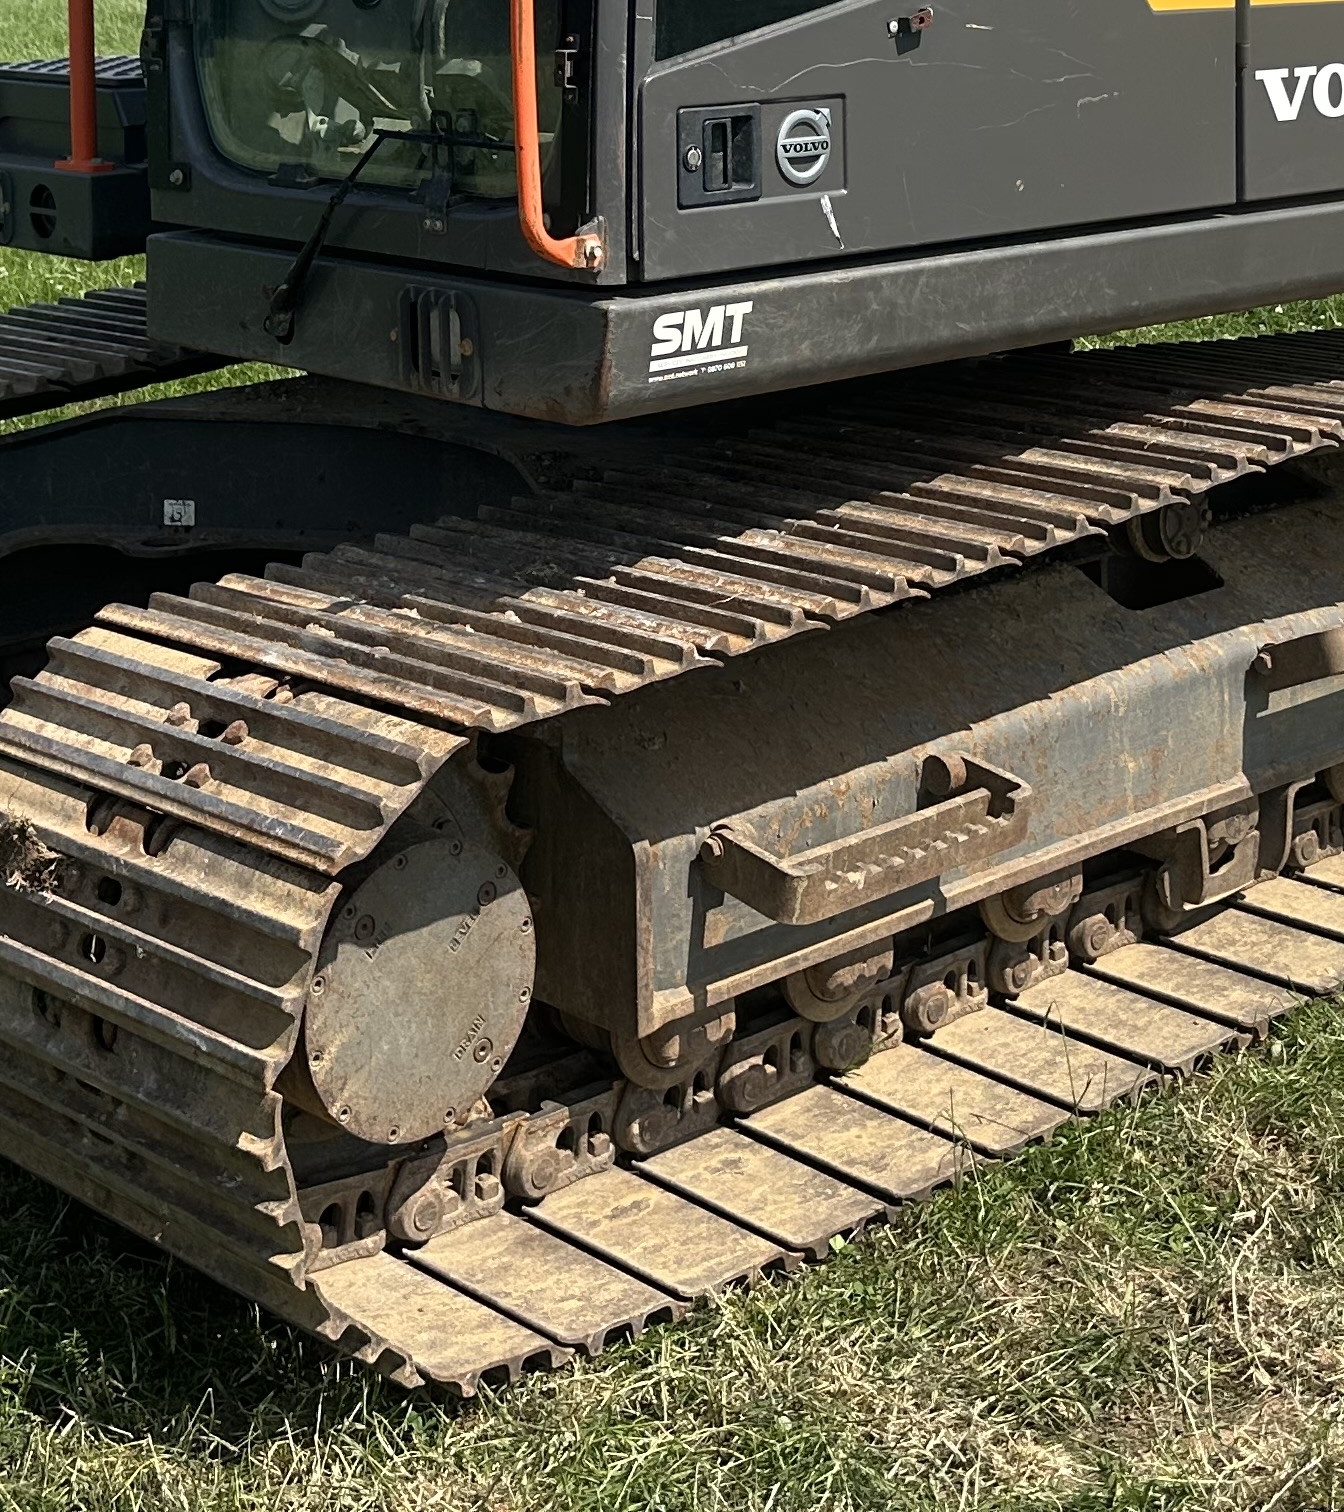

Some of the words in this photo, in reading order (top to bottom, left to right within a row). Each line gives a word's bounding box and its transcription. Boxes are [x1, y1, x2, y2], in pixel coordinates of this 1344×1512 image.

[780, 140, 829, 154] VOLVO
[651, 300, 754, 357] SMT
[453, 1014, 486, 1061] DRAIN
